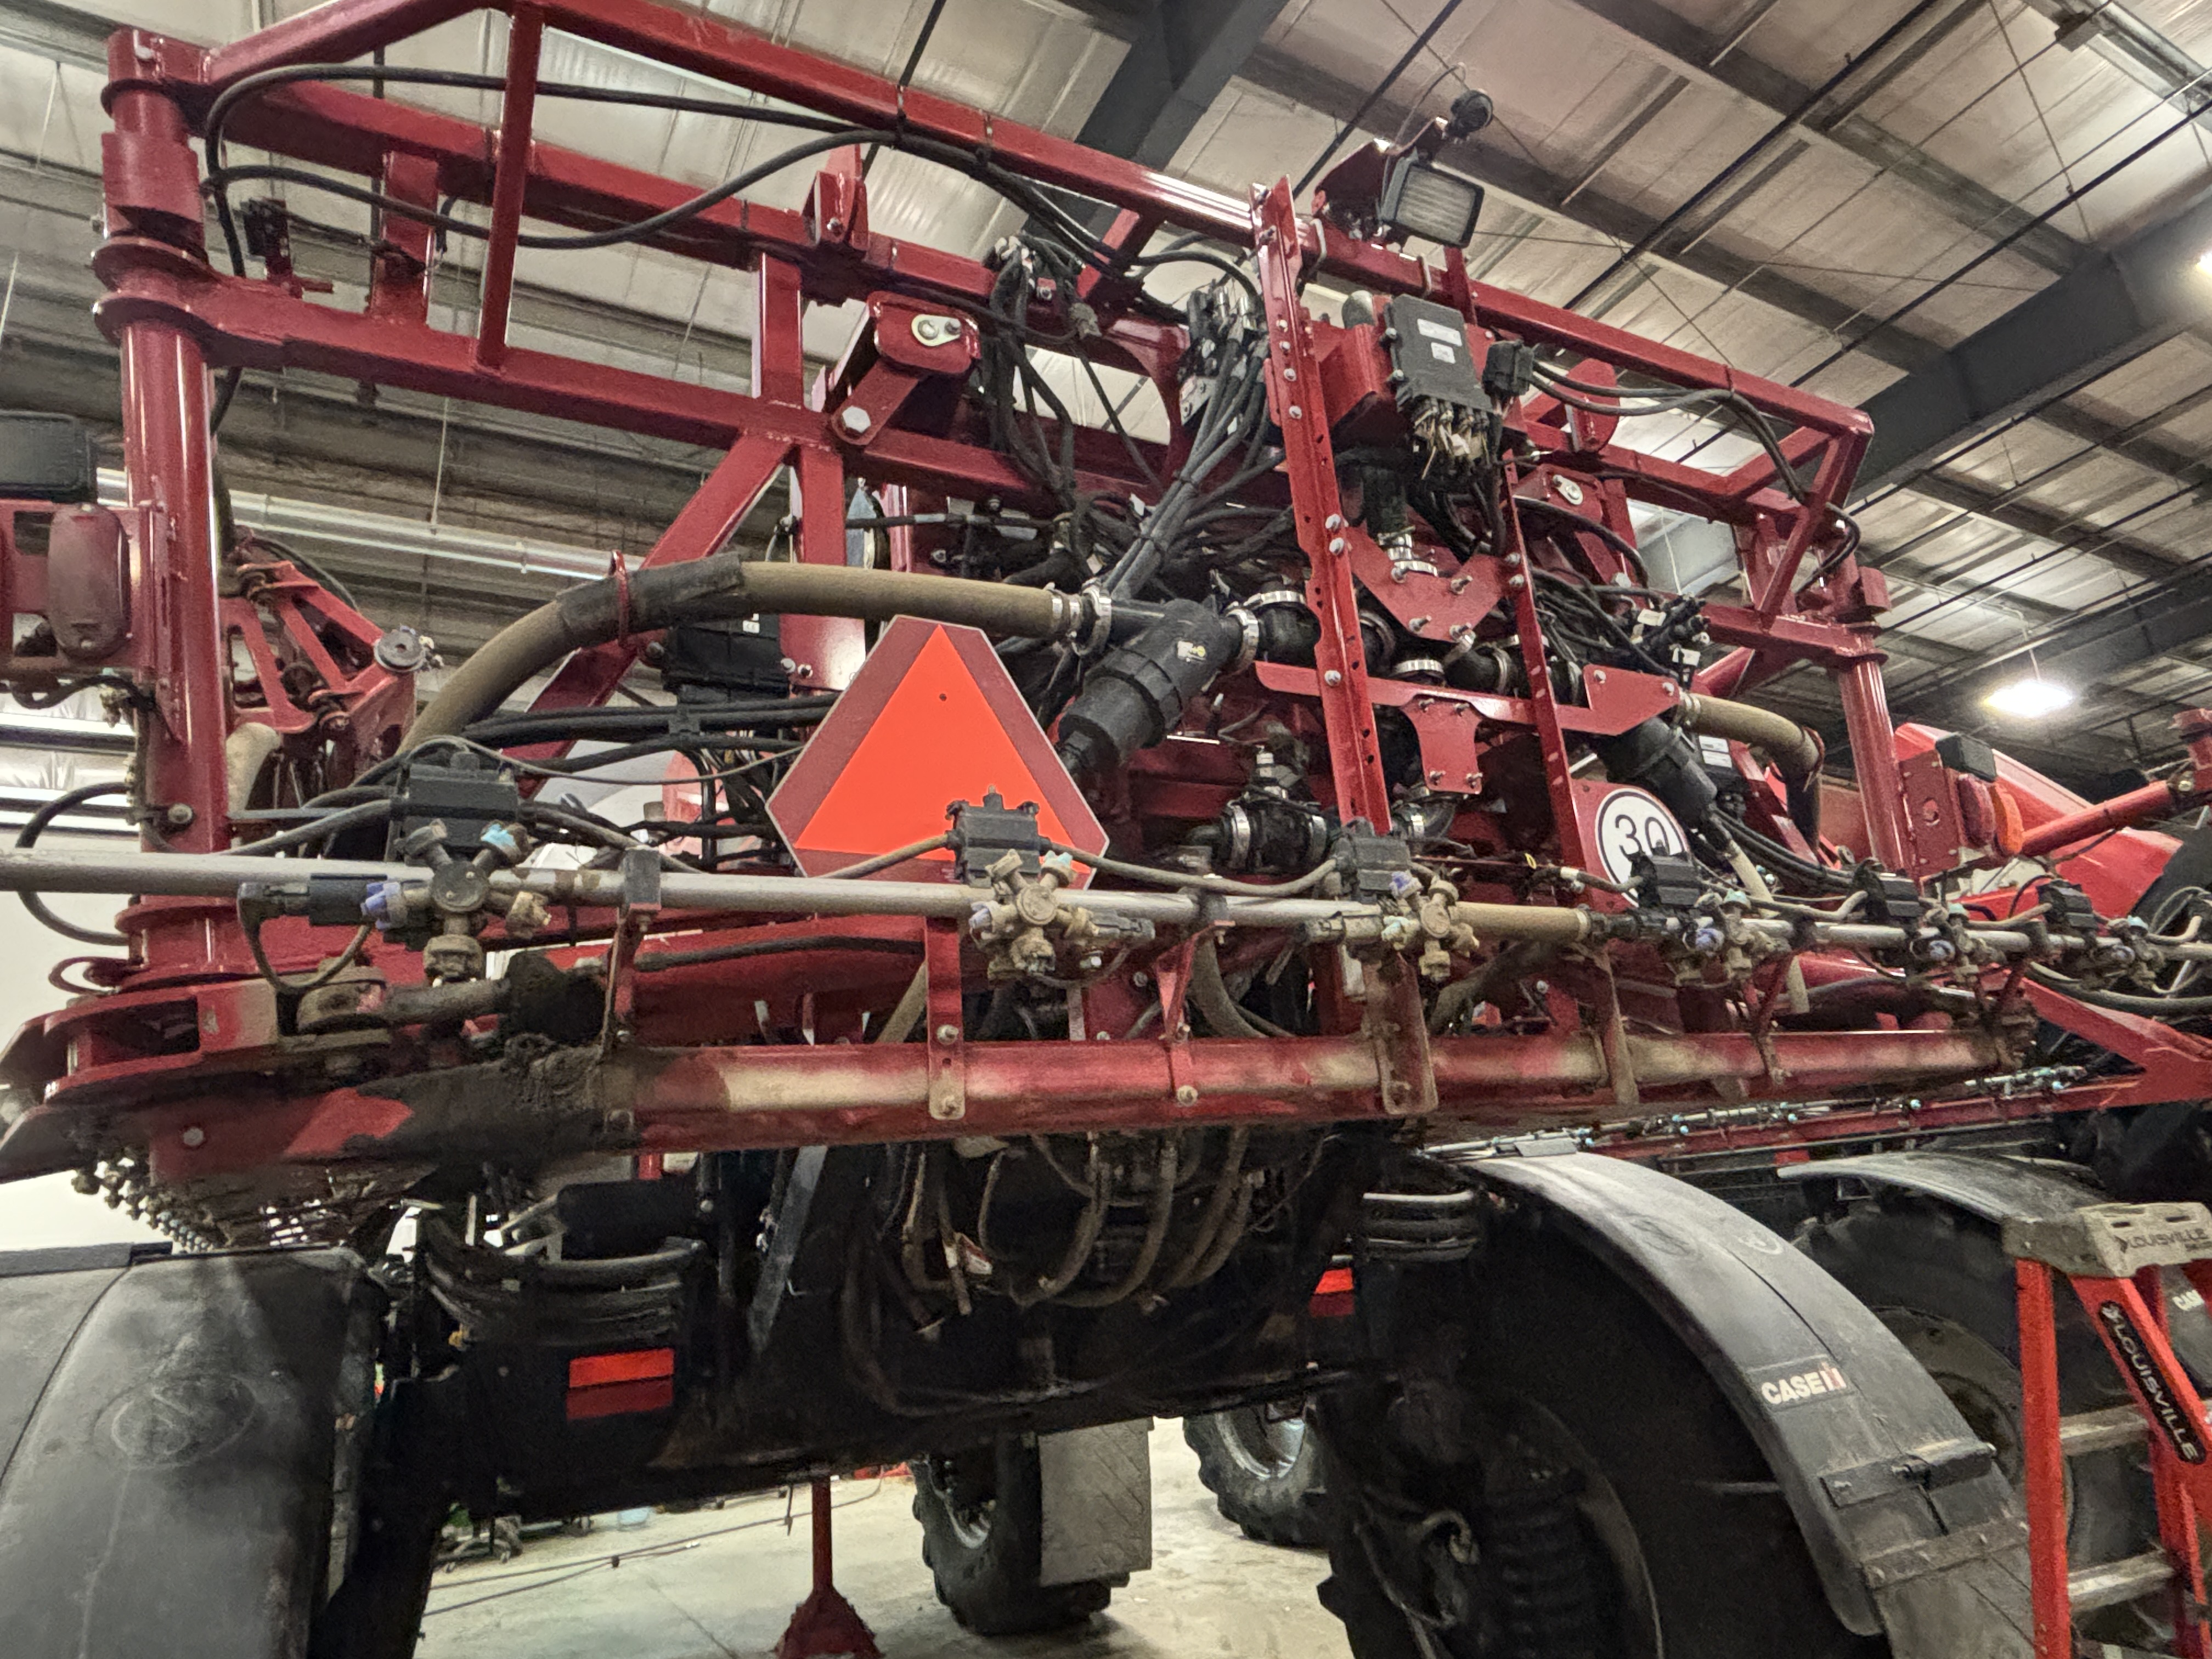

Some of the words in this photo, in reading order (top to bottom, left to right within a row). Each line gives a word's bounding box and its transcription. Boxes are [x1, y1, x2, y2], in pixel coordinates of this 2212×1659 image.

[1615, 814, 1670, 859] 30
[2172, 1289, 2205, 1311] CAS
[2113, 1323, 2198, 1460] LOUISVILLE
